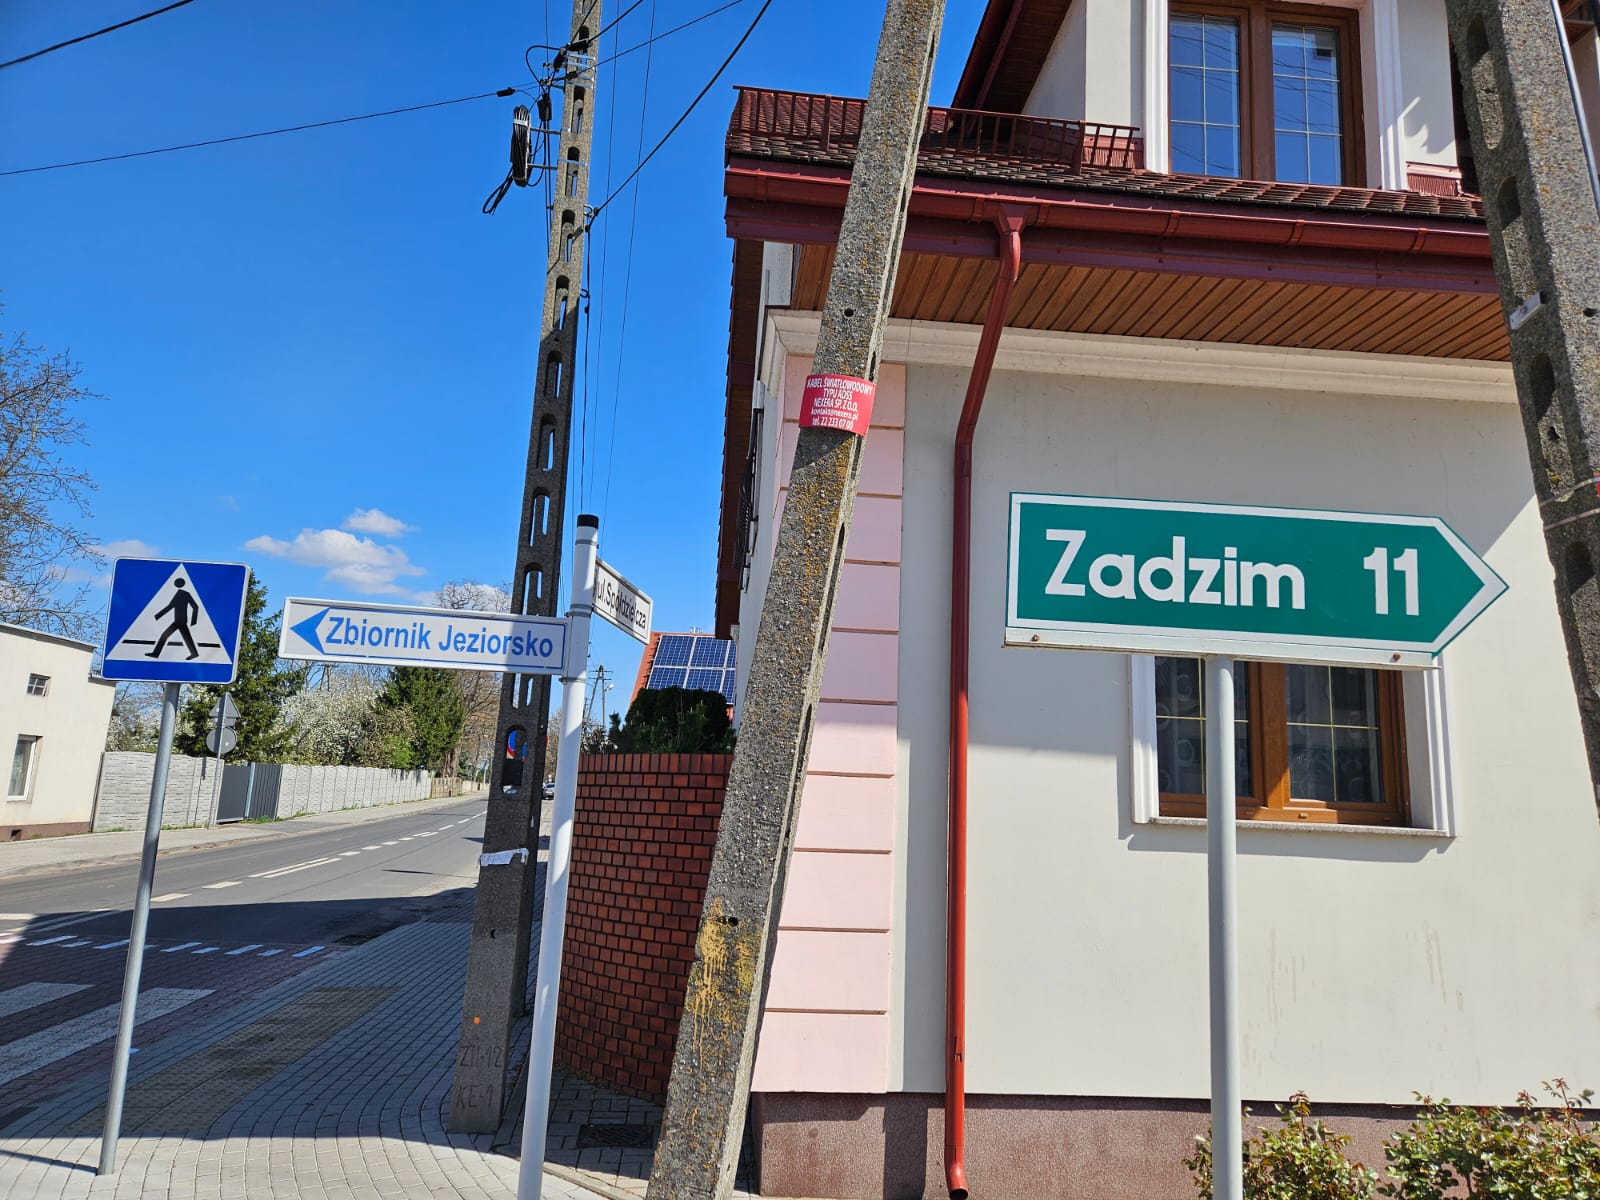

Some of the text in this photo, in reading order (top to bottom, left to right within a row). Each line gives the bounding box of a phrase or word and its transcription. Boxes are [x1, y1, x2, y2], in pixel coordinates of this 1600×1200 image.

[807, 376, 873, 395] KABEL ŚWIATŁOWODOWY
[823, 388, 837, 398] TYPU
[814, 398, 834, 408] NEXERA
[821, 417, 828, 426] 22
[1045, 529, 1420, 616] Zadzim 11
[326, 616, 553, 658] Zbiornik Jeziorsko
